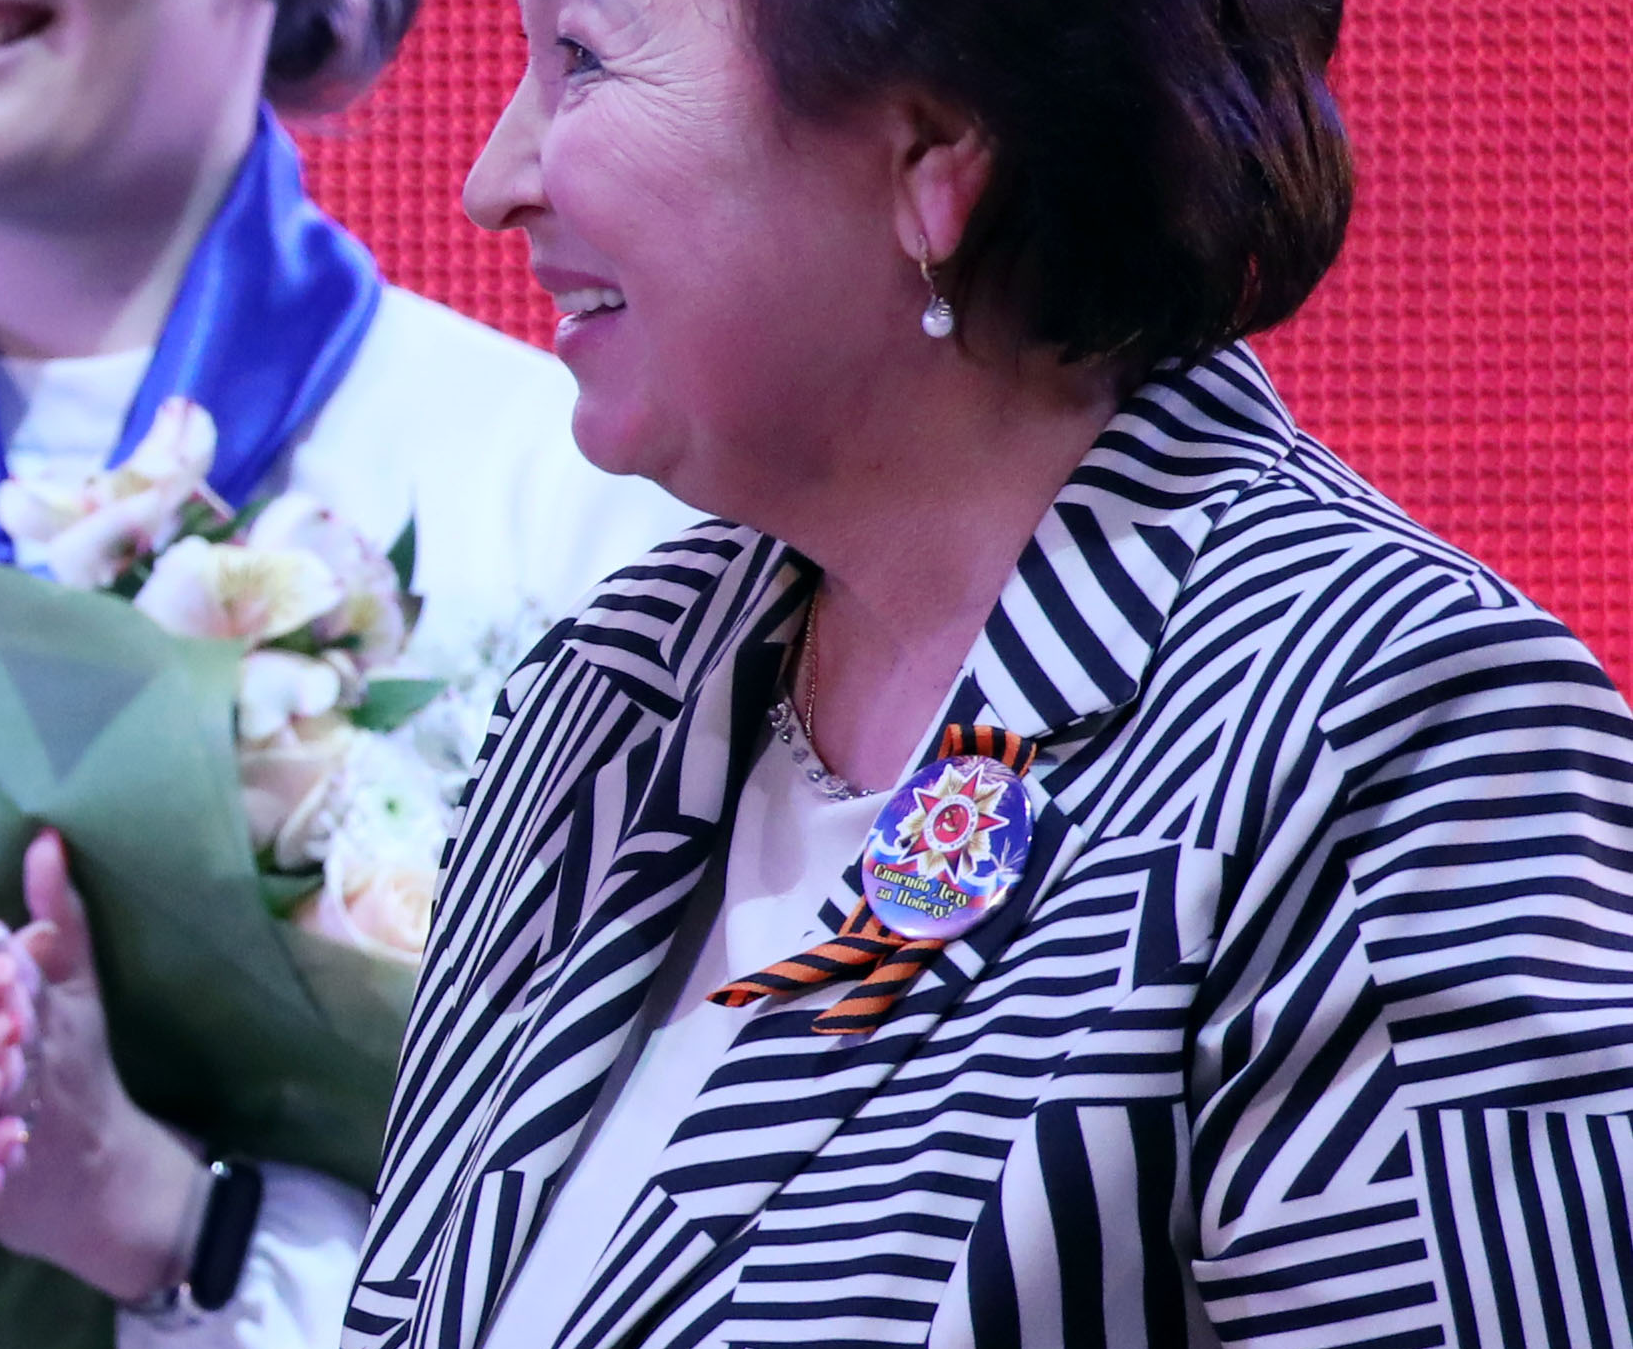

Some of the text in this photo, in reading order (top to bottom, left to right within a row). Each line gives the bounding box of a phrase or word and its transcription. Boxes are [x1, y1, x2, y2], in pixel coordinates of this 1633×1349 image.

[873, 863, 970, 908] Спасибо Деду
[876, 886, 955, 920] за Победу!
